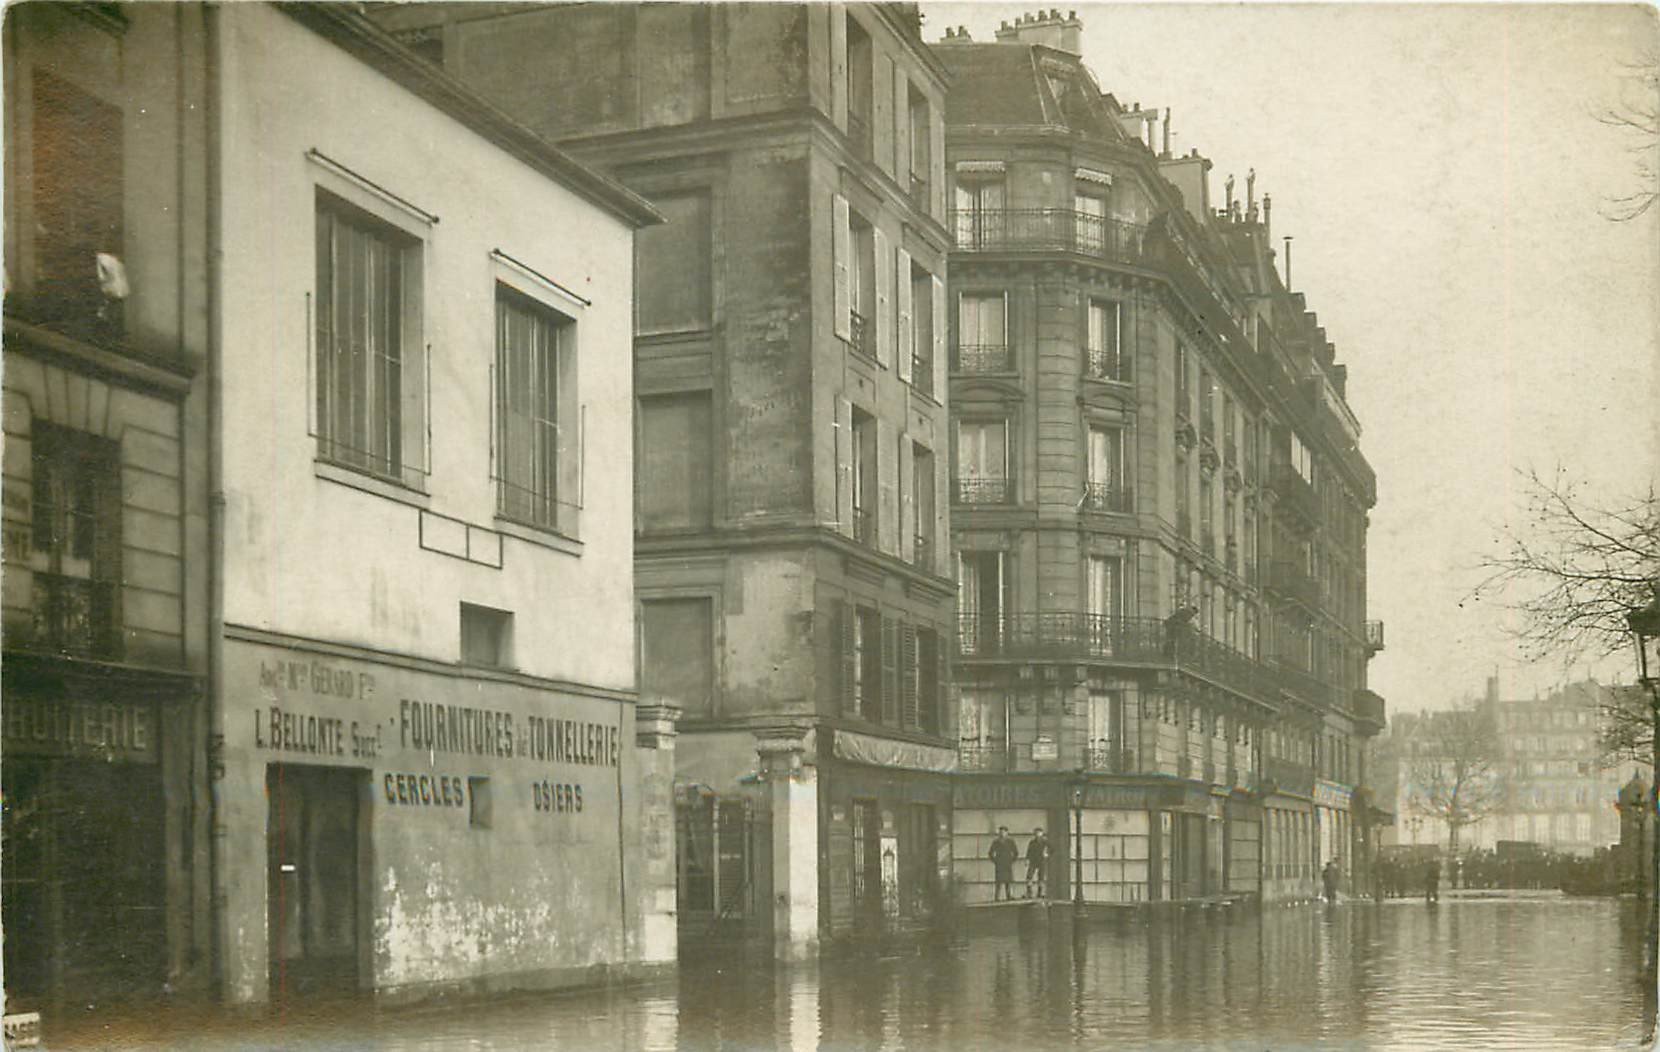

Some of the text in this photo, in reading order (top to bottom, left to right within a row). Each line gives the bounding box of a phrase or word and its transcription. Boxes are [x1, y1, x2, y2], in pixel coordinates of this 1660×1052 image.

[400, 698, 513, 758] FOURNITURES
[528, 714, 618, 768] TONNELLERIE
[384, 772, 464, 808] CERCLES
